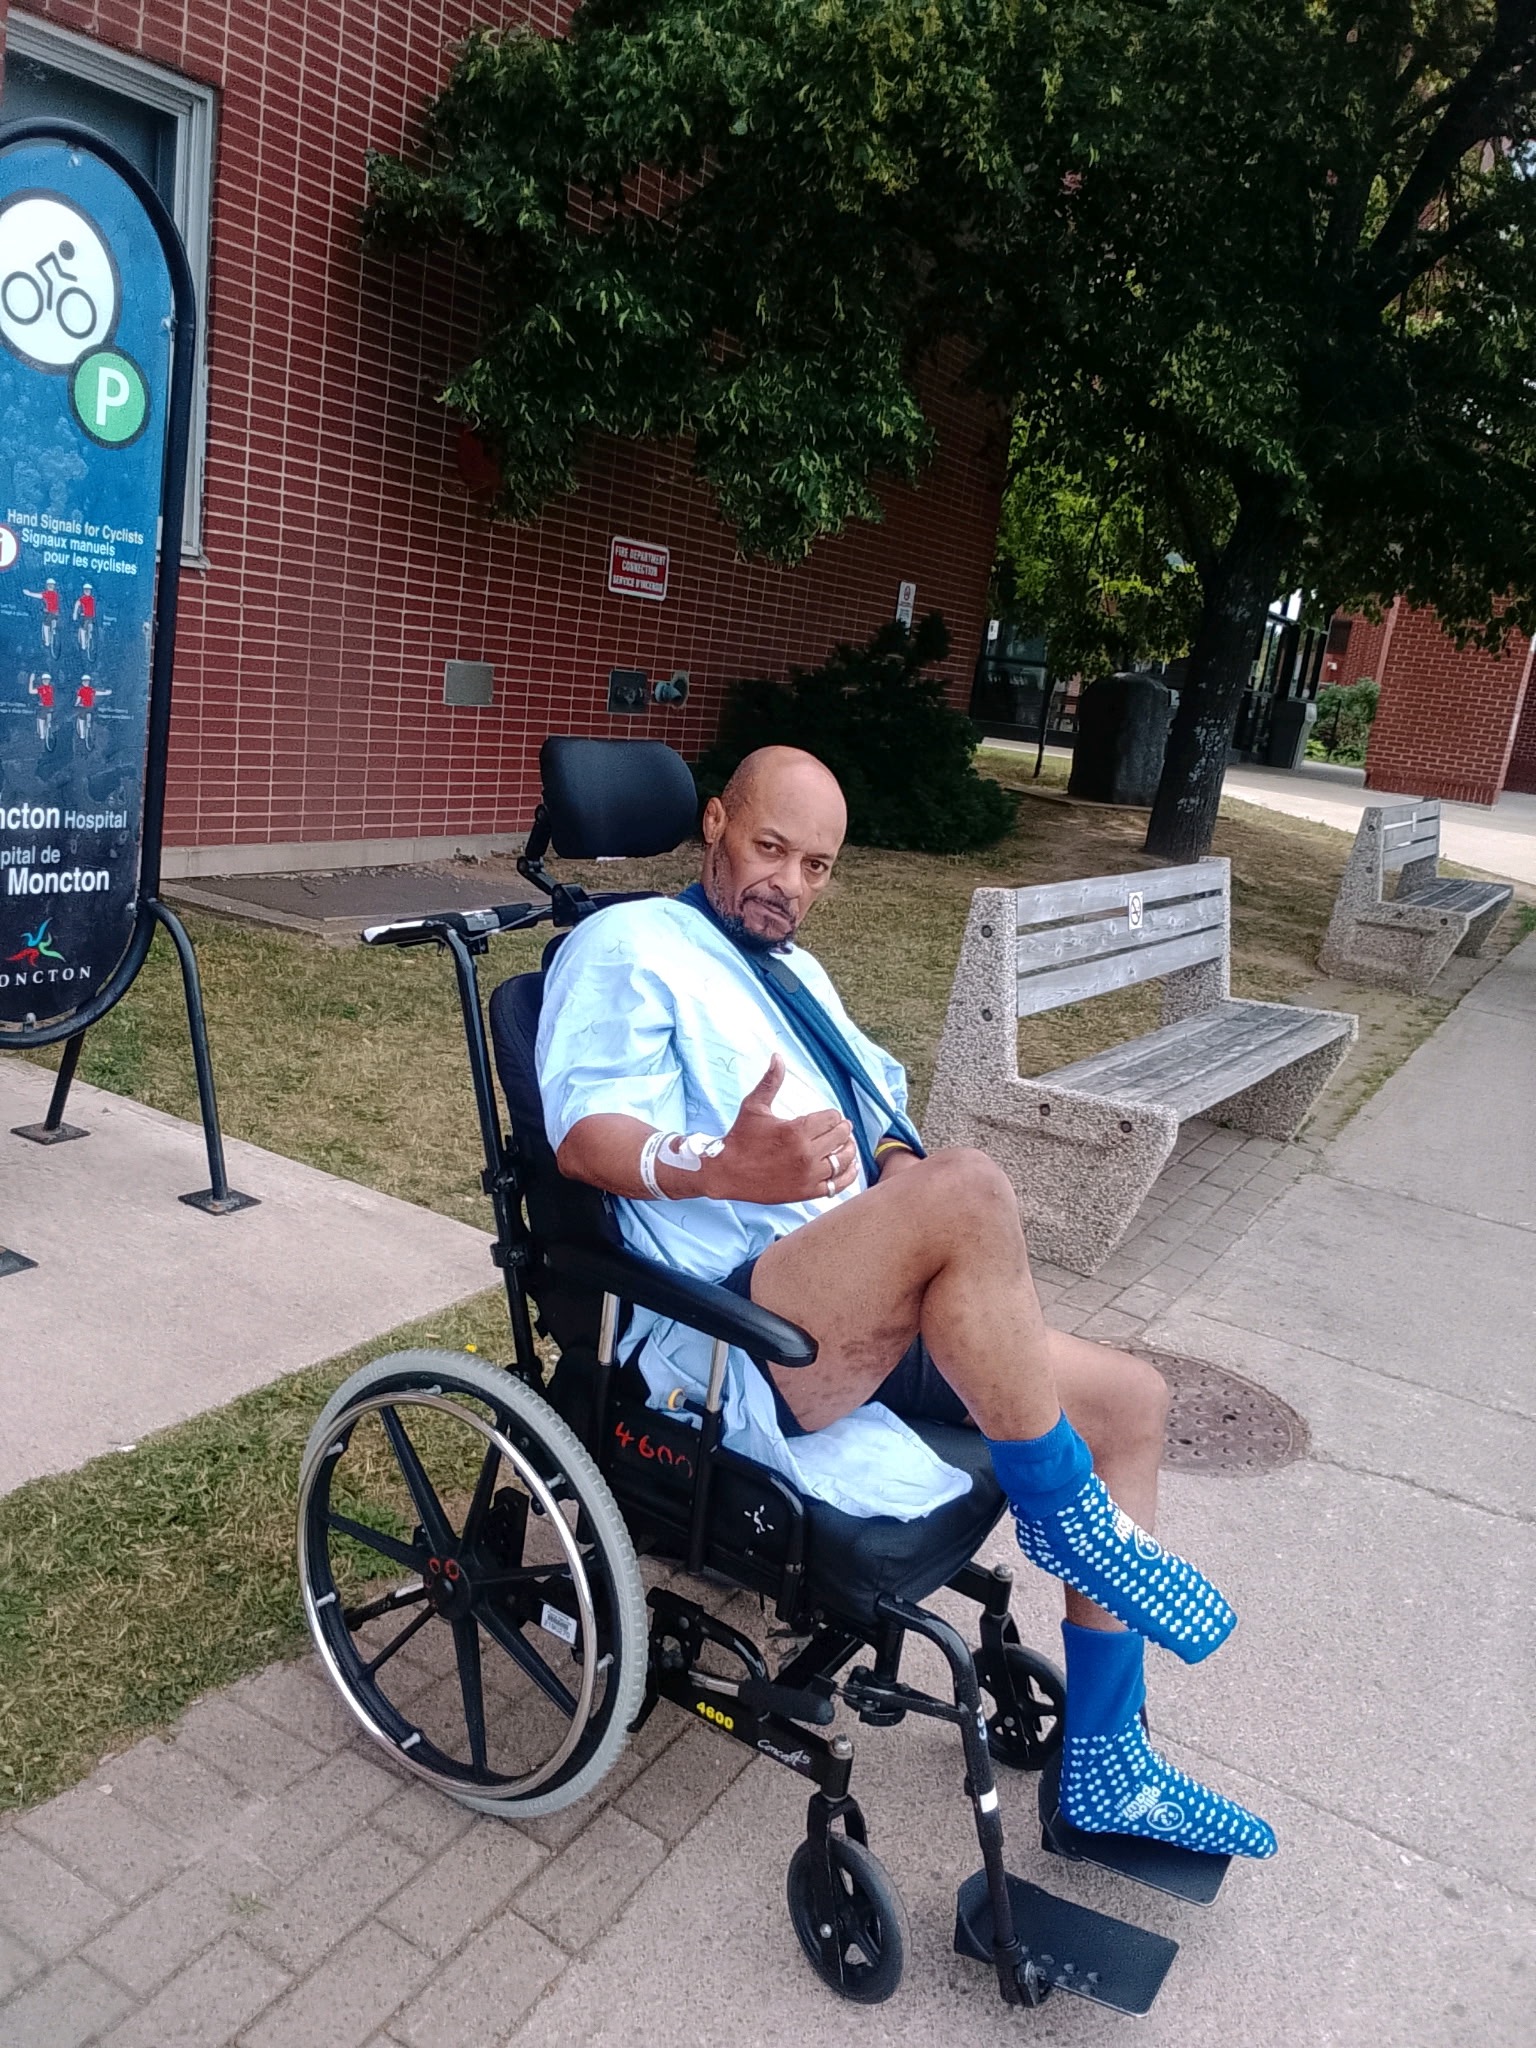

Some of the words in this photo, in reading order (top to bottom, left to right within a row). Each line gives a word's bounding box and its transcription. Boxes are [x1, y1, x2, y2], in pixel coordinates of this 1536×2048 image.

[96, 366, 130, 427] P
[7, 508, 38, 527] Hand
[40, 514, 82, 534] Signals
[84, 521, 100, 537] for
[102, 525, 144, 545] Cyclists
[21, 527, 67, 548] Signaux
[70, 538, 116, 557] manuels
[43, 550, 70, 566] pour
[72, 552, 89, 568] les
[91, 557, 138, 575] cyclistes
[64, 810, 128, 833] Hospital
[40, 845, 61, 863] de
[8, 867, 110, 895] Moncton
[696, 1701, 734, 1731] 4600
